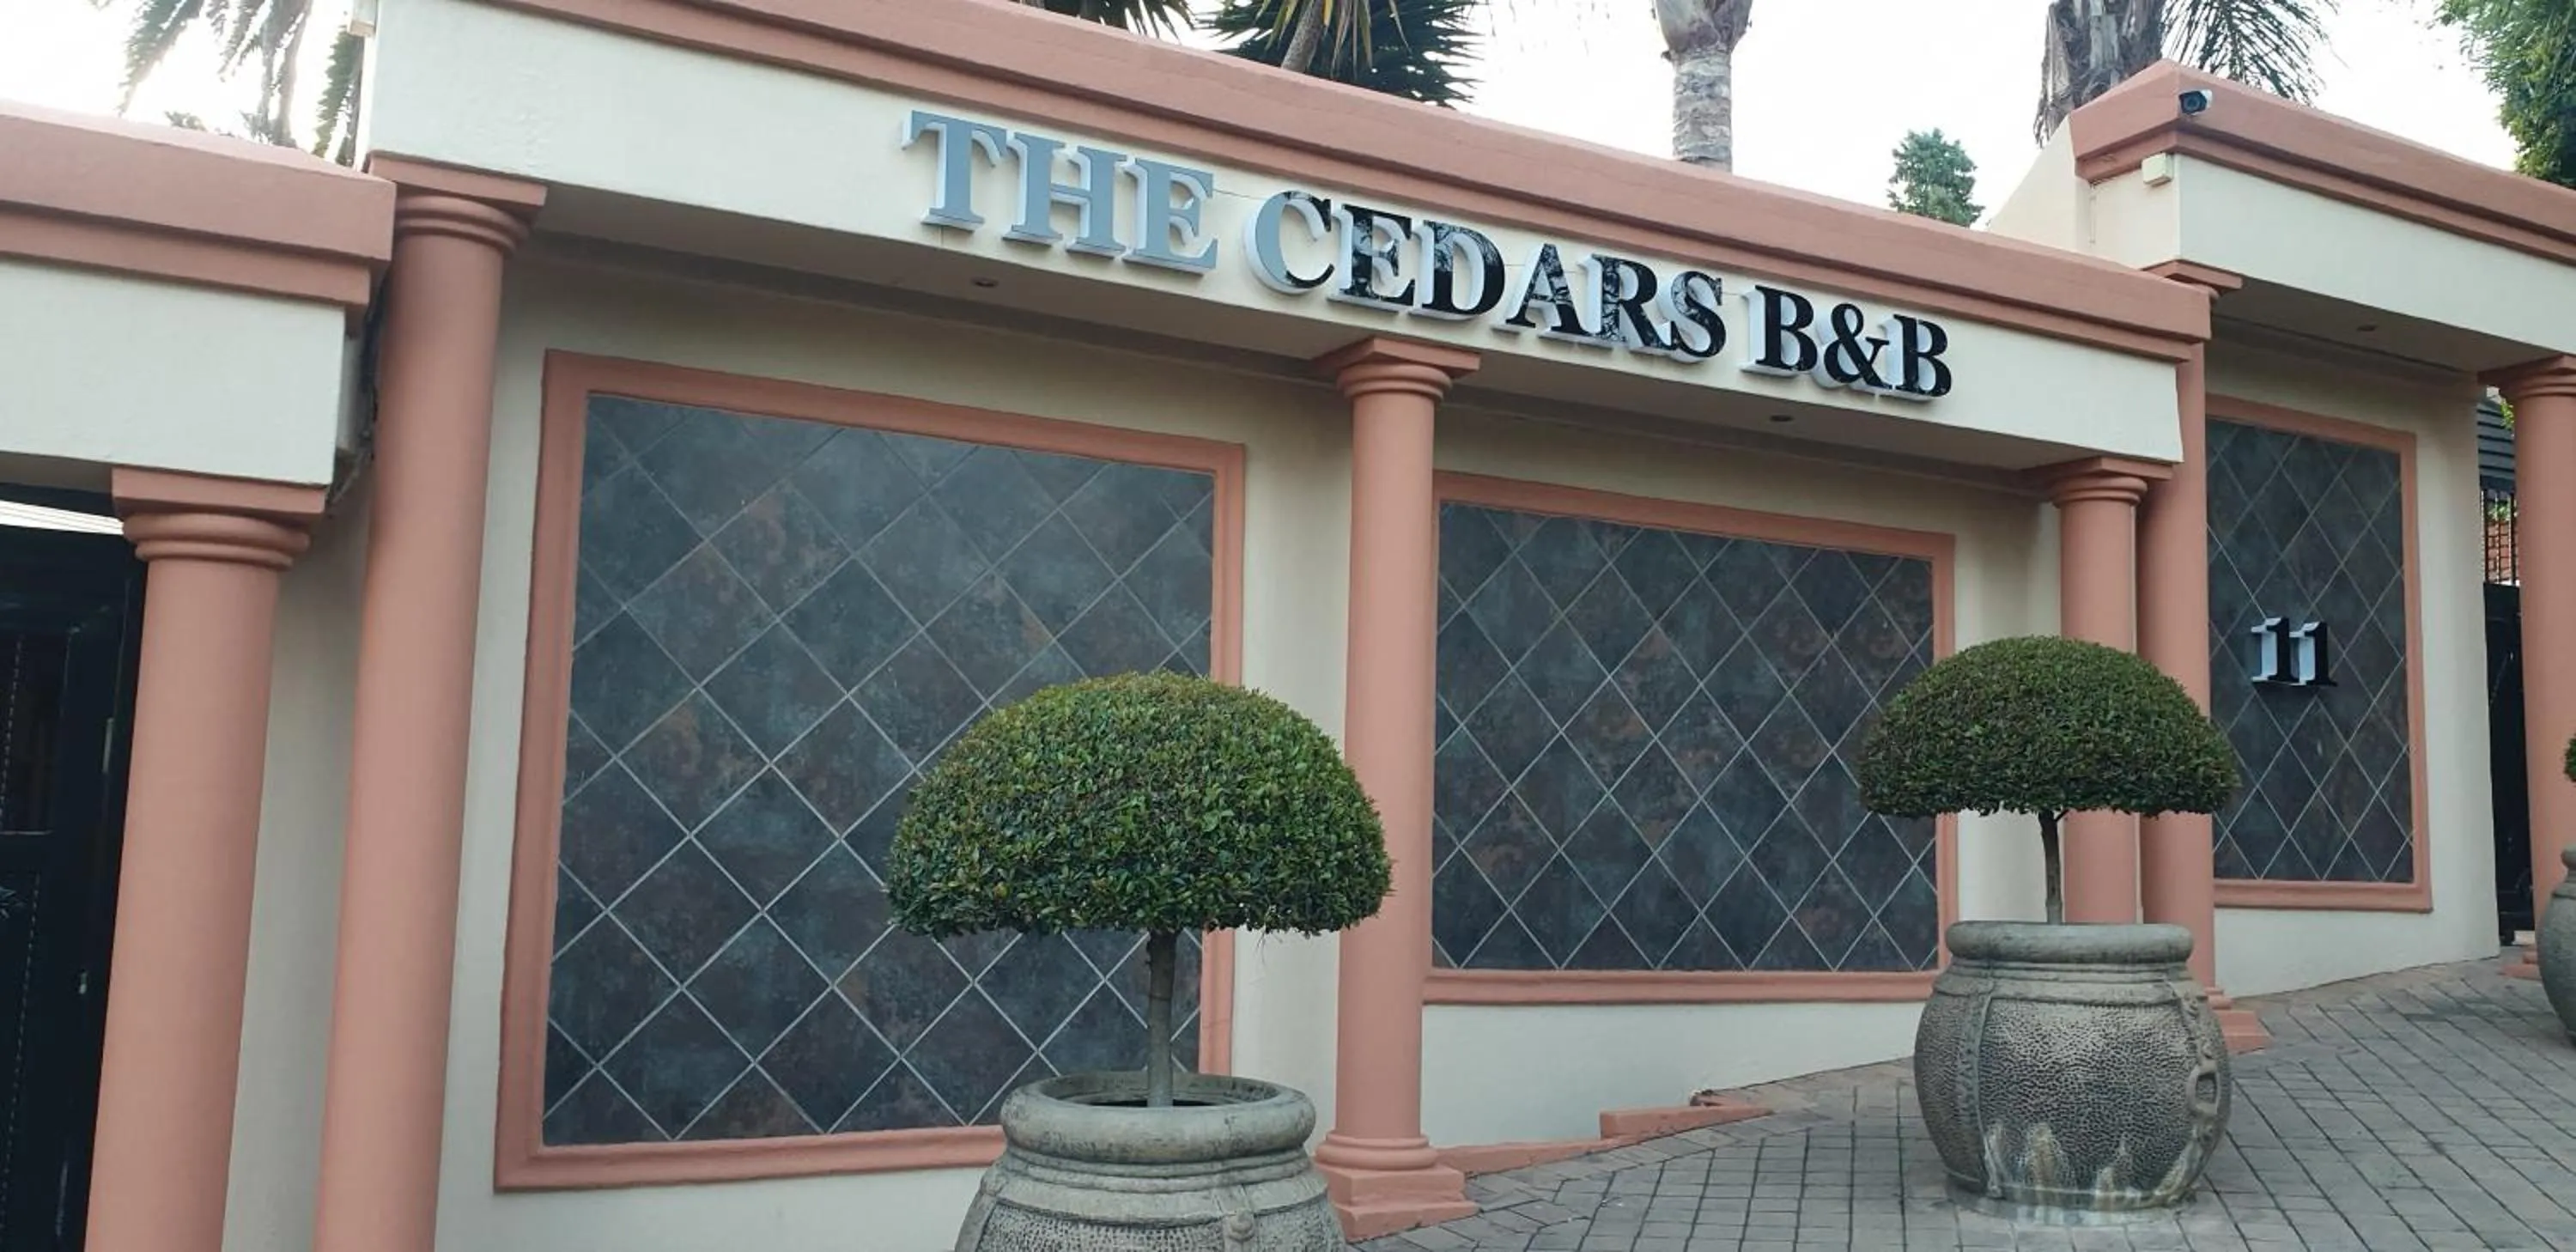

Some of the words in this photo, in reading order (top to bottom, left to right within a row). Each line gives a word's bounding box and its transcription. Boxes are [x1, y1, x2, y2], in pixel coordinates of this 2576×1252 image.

[902, 110, 1219, 275] THE
[1244, 190, 1728, 362] CEDARS
[1742, 284, 1953, 401] B&B
[2251, 616, 2338, 686] 11
